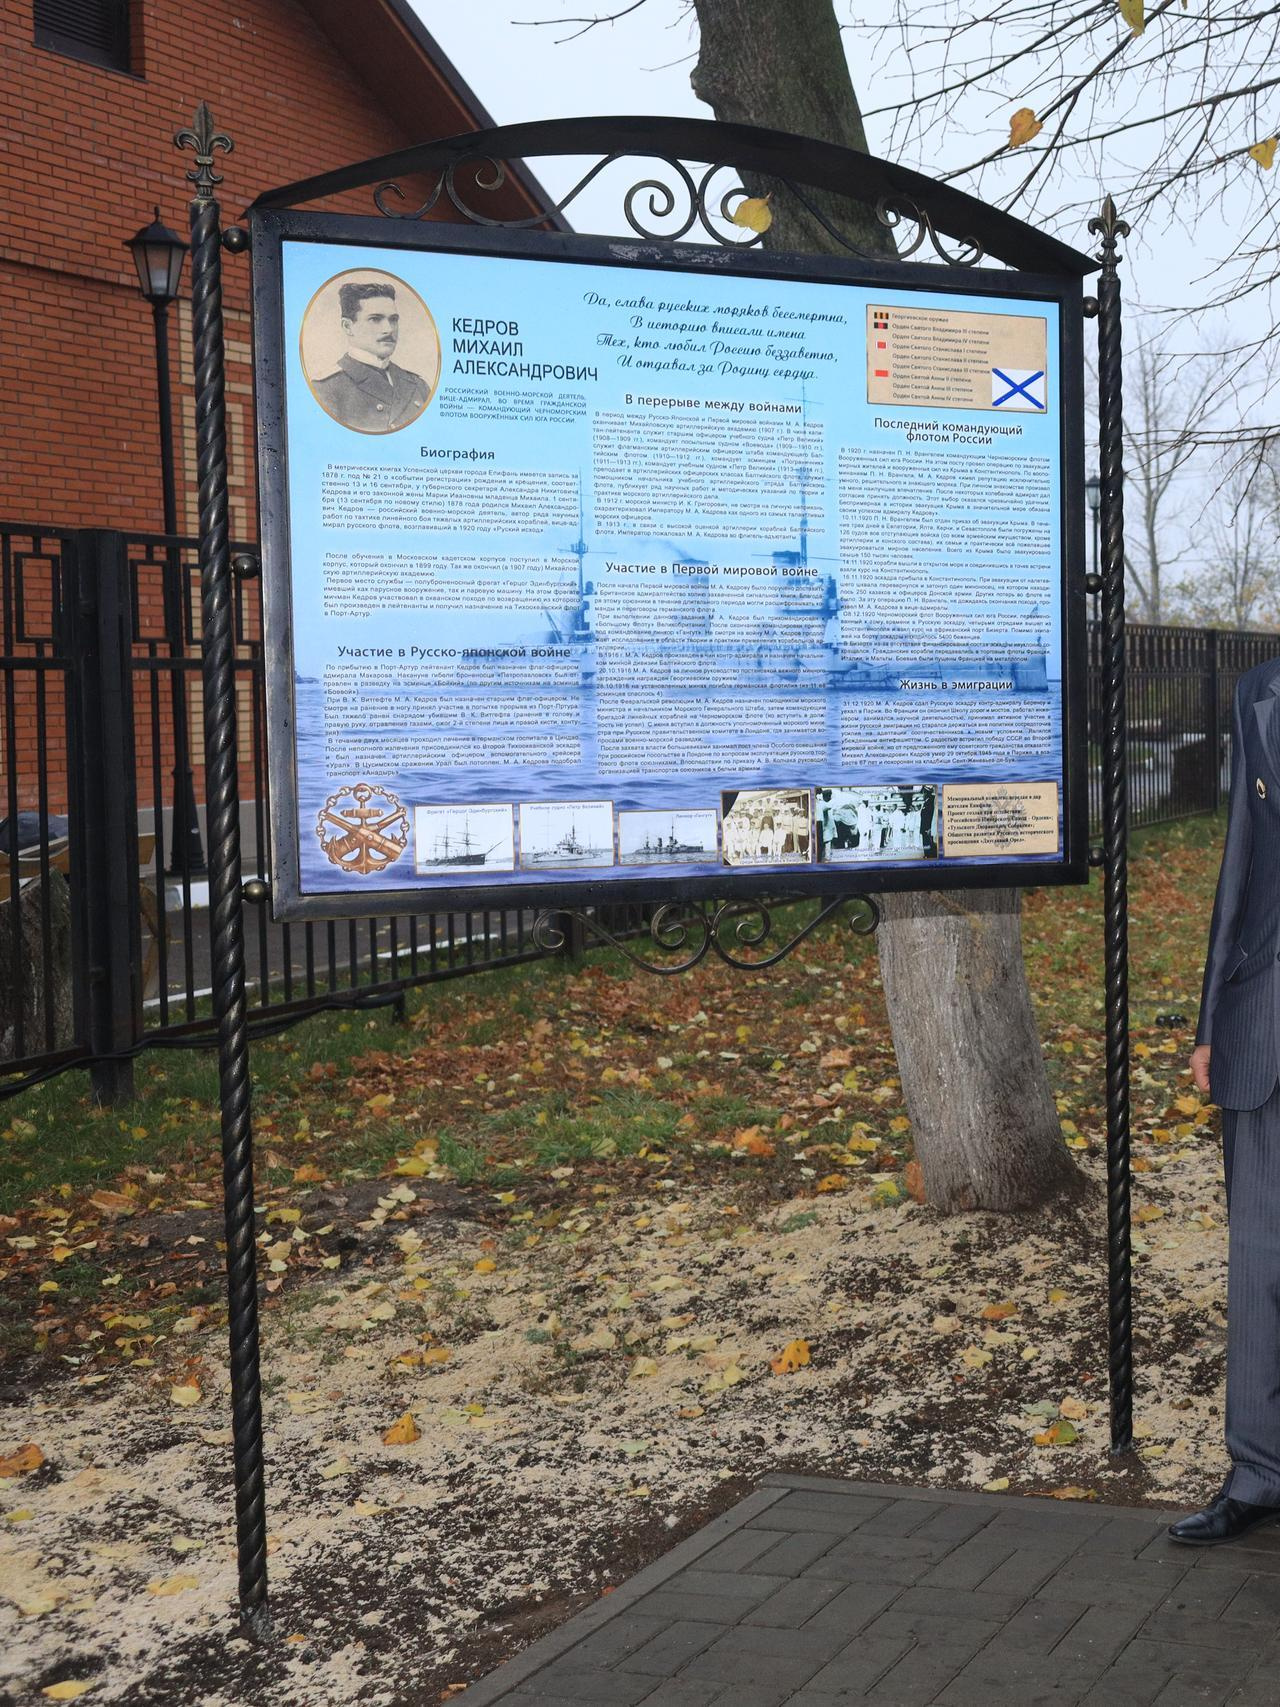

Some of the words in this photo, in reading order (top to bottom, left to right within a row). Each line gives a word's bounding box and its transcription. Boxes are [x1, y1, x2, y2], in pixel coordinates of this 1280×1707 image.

[582, 291, 611, 307] Да,
[614, 293, 655, 309] слава
[657, 297, 710, 315] русских
[712, 301, 769, 320] моряков
[771, 305, 847, 325] бессмертна,
[452, 317, 519, 339] КЕДРОВ
[647, 320, 707, 335] историю
[711, 320, 763, 336] вписали
[766, 329, 805, 339] имена
[452, 338, 523, 357] МИХАИЛ
[596, 332, 630, 348] Тех,
[633, 335, 661, 349] кто
[663, 337, 707, 352] любил
[709, 340, 763, 358] Россию
[452, 358, 598, 384] АЛЕКСАНДРОВИЧ
[616, 354, 632, 367] И
[635, 355, 695, 373] отдавал
[717, 360, 769, 378] Родину
[637, 396, 701, 410] перерыве
[704, 400, 745, 413] между
[748, 400, 801, 413] войнами
[874, 417, 939, 435] Последний
[941, 421, 1023, 439] командующий
[905, 428, 950, 444] флотом
[952, 431, 992, 444] России
[420, 446, 495, 462] Биография
[605, 562, 656, 573] Участие
[671, 563, 719, 576] Первой
[722, 564, 777, 578] мировой
[781, 564, 818, 576] войне
[337, 646, 393, 657] Участие
[410, 645, 526, 661] Русско-японской
[530, 646, 572, 657] войне
[899, 679, 937, 690] Жизнь
[951, 681, 1013, 692] эмиграции
